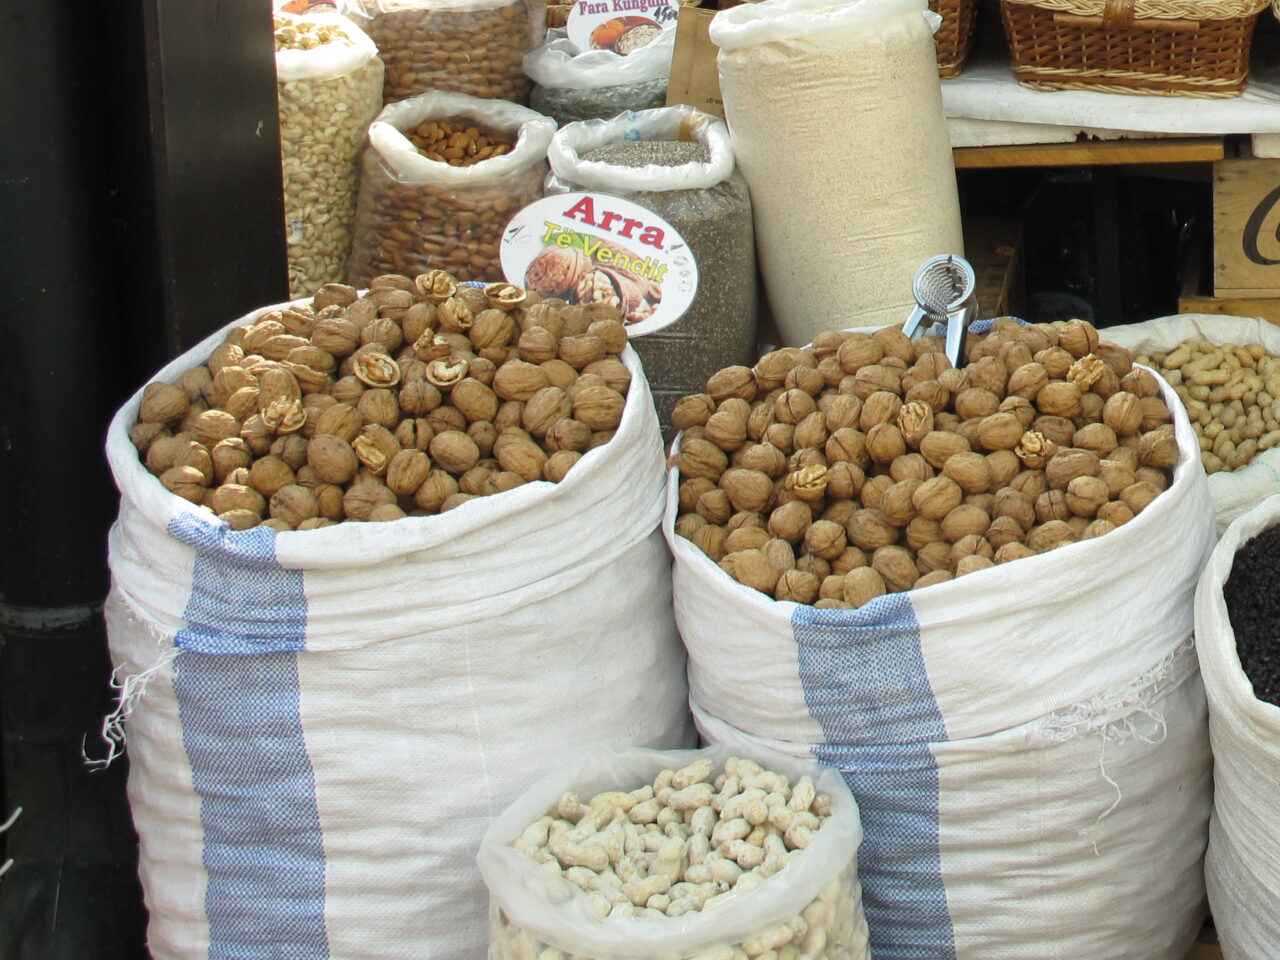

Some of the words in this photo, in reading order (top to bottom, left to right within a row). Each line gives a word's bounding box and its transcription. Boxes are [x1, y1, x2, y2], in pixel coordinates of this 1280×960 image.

[579, 1, 609, 15] Fara
[563, 196, 665, 250] Arra
[541, 220, 574, 248] Të
[583, 237, 669, 283] Vendit
